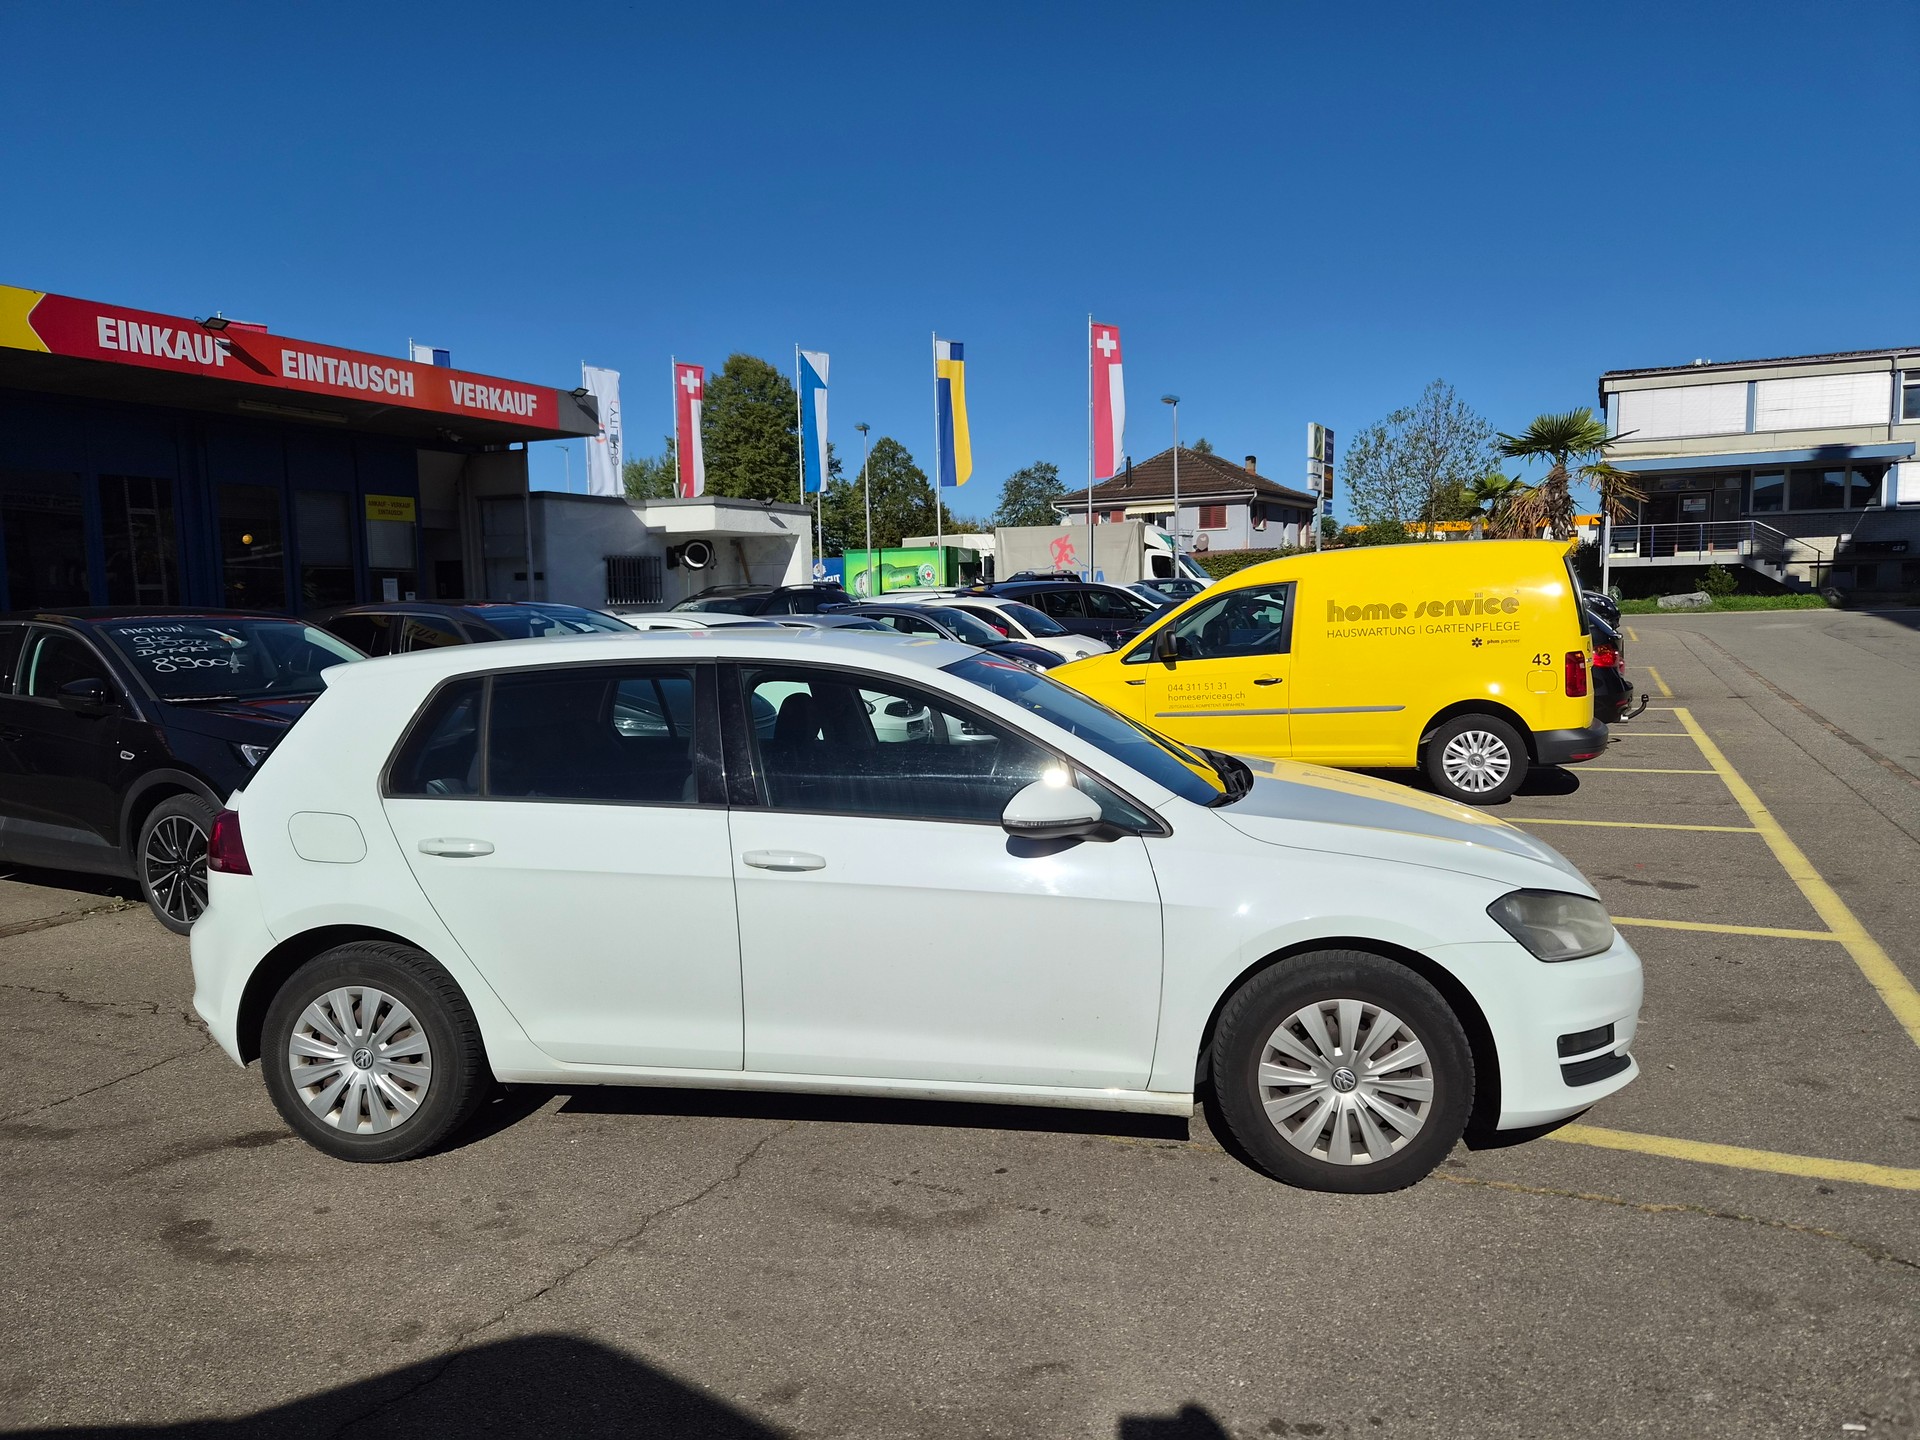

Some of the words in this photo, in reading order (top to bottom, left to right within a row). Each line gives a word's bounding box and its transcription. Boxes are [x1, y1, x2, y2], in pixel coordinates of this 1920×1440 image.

[97, 316, 231, 367] EINKAUF
[281, 349, 415, 398] EINTAUSCH
[449, 379, 538, 417] VERKAUF
[1327, 600, 1408, 622] home
[1414, 592, 1520, 619] service
[1327, 626, 1416, 638] HAUSWARTUNG
[1425, 621, 1520, 635] GARTENPFLEGE
[1532, 653, 1551, 666] 43
[1168, 684, 1183, 692] 044
[1186, 683, 1201, 691] 311
[1217, 682, 1227, 690] 31
[1168, 691, 1246, 701] homeserviceag.ch
